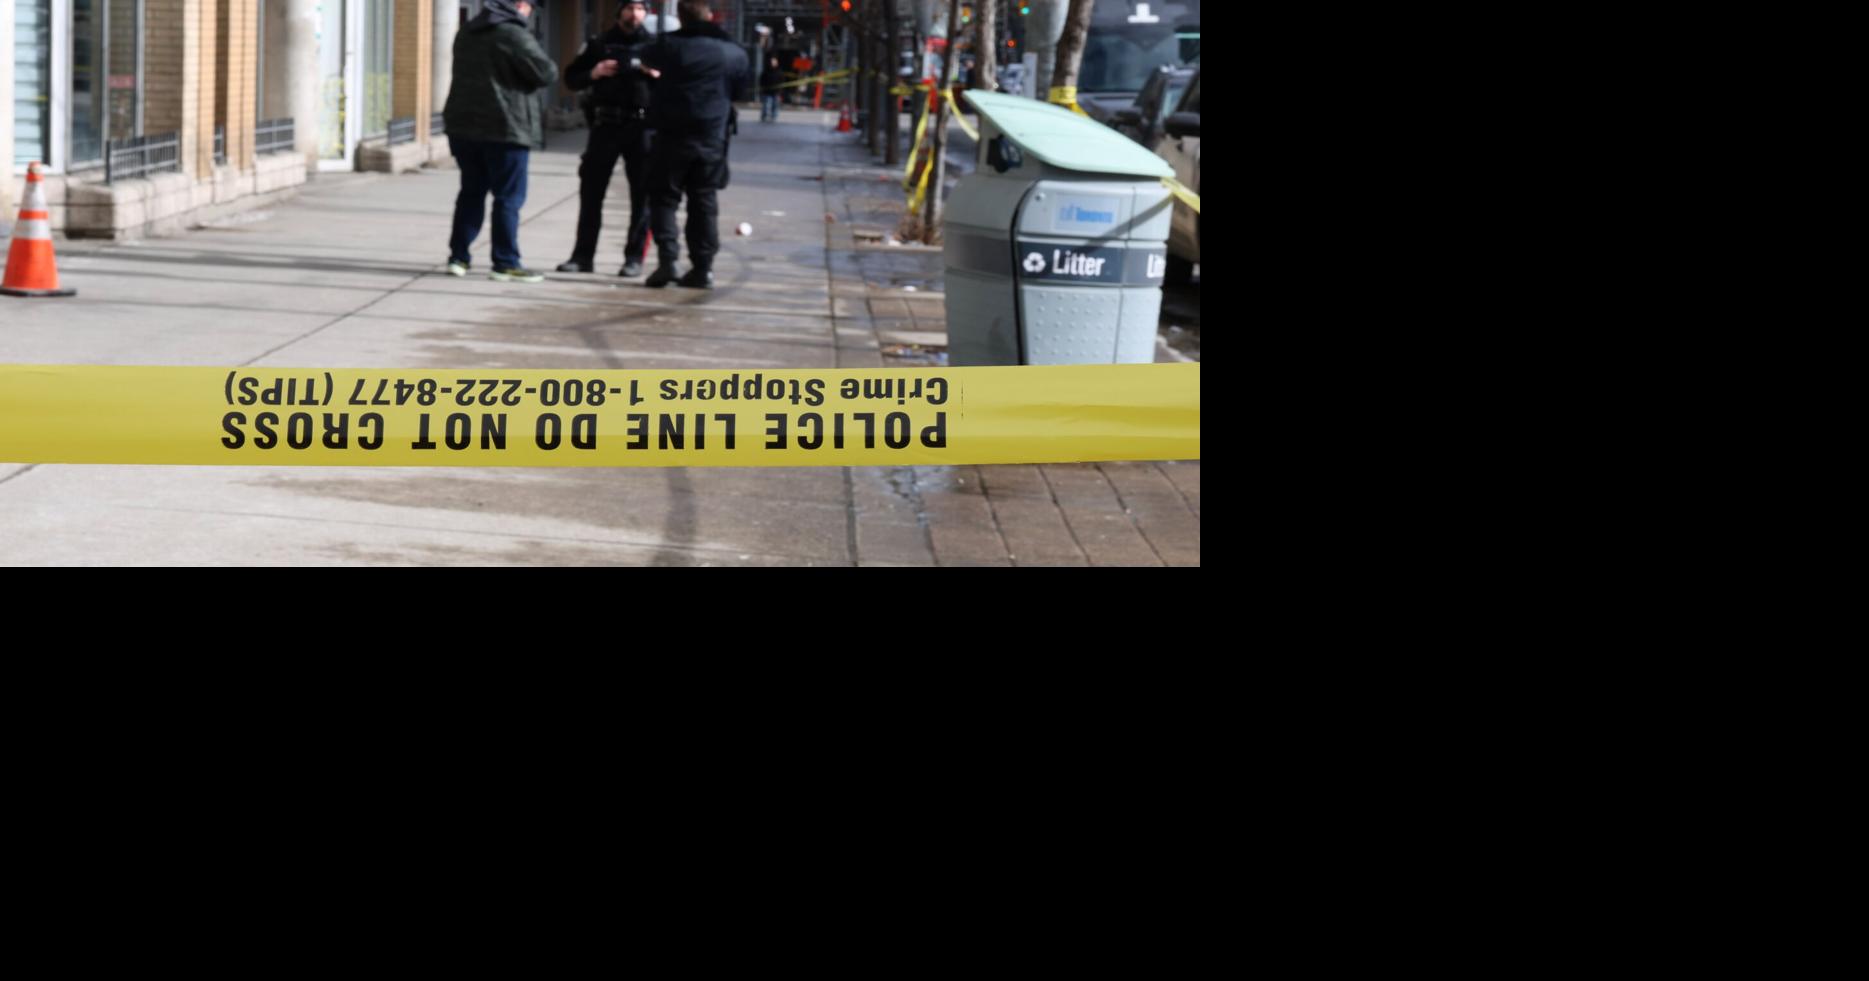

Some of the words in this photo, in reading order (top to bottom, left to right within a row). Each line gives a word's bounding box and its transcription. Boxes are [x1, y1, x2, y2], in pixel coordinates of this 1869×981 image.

[1052, 249, 1105, 276] Litter
[225, 371, 334, 406] (TIPS)
[348, 378, 644, 407] 1-800-222-8477
[659, 373, 826, 407] Stoppers
[840, 377, 948, 406] Crime
[221, 411, 385, 451] CROSS
[411, 412, 507, 451] NOT
[535, 412, 598, 451] DO
[626, 413, 736, 450] LINE
[765, 411, 947, 450] POLICE
